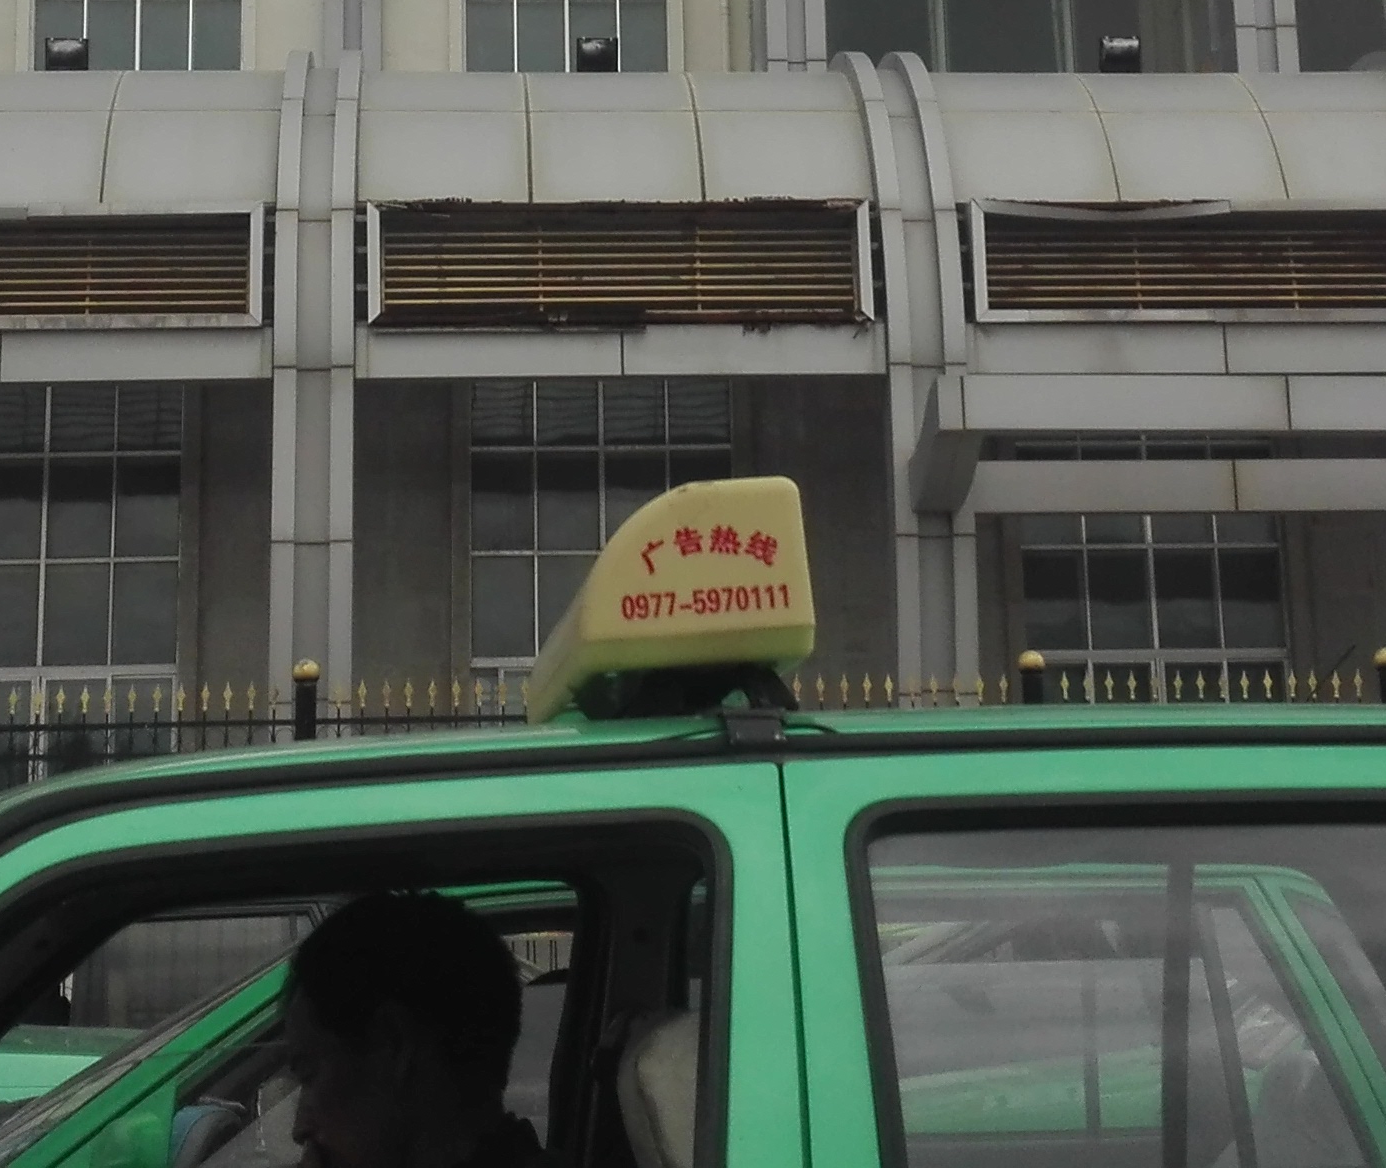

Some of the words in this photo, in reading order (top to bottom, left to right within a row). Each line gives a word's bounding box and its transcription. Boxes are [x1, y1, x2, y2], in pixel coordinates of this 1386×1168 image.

[640, 525, 778, 575] 广告热线
[621, 583, 790, 620] 0977-5970111
